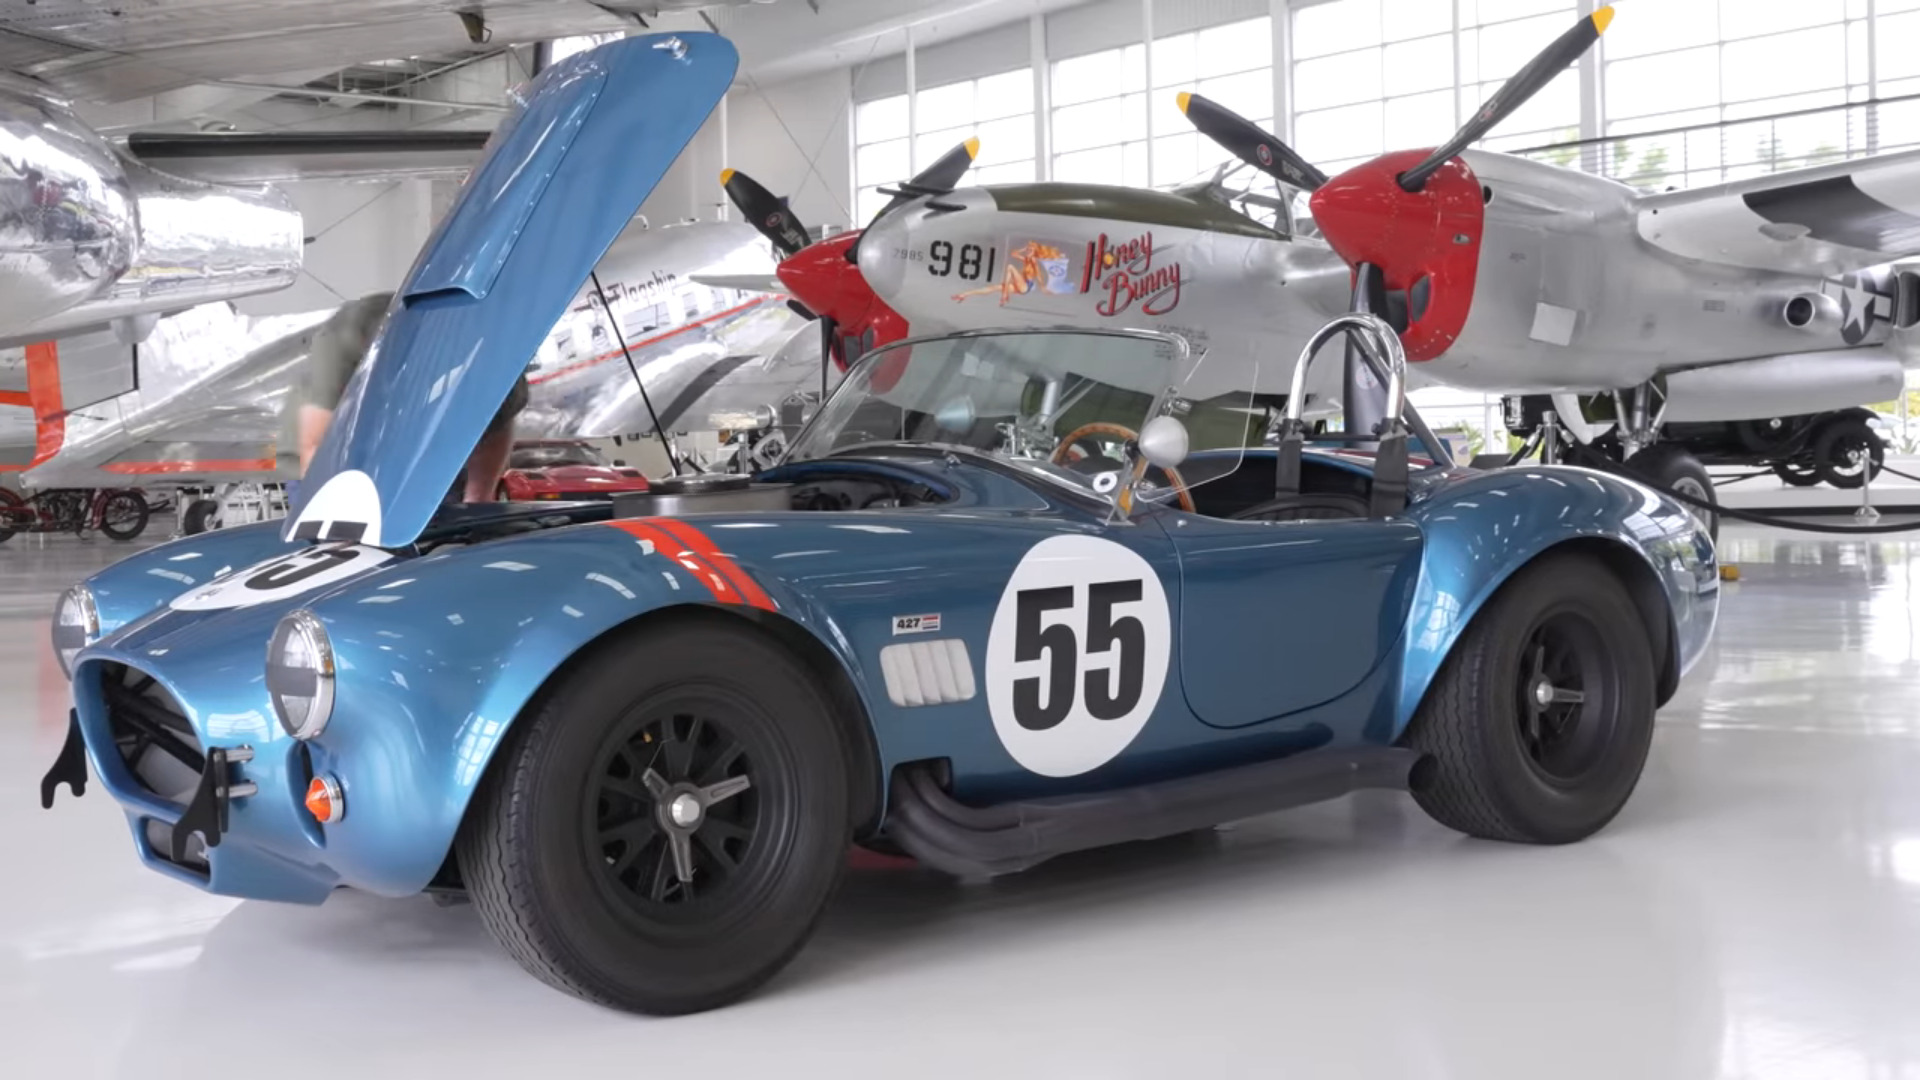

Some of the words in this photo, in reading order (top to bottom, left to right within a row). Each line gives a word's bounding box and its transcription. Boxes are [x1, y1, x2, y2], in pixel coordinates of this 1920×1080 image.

[928, 240, 996, 283] 981
[1096, 261, 1180, 317] Bunny
[897, 617, 921, 629] 427
[1012, 578, 1146, 731] 55
